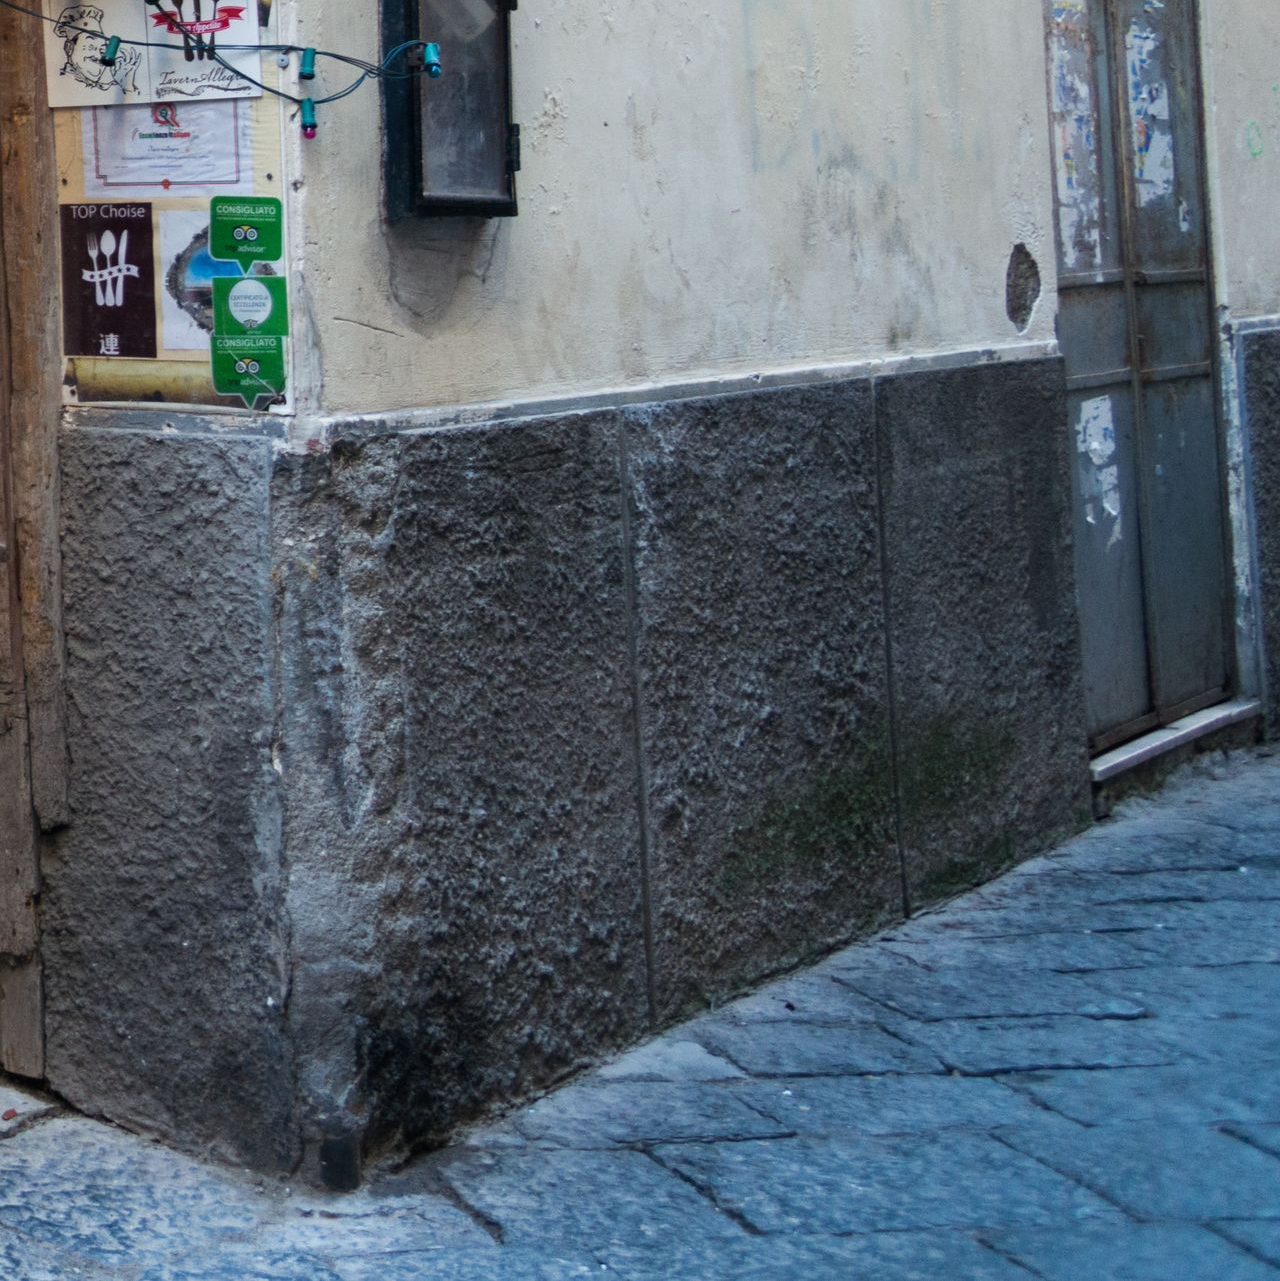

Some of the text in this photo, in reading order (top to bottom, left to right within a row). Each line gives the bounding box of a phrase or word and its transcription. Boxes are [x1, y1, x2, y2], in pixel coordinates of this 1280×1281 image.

[69, 204, 147, 219] TOP Choise
[216, 205, 276, 215] CONSIGLIATO
[99, 333, 120, 355] 連
[216, 338, 277, 347] CONSIGLIATO
